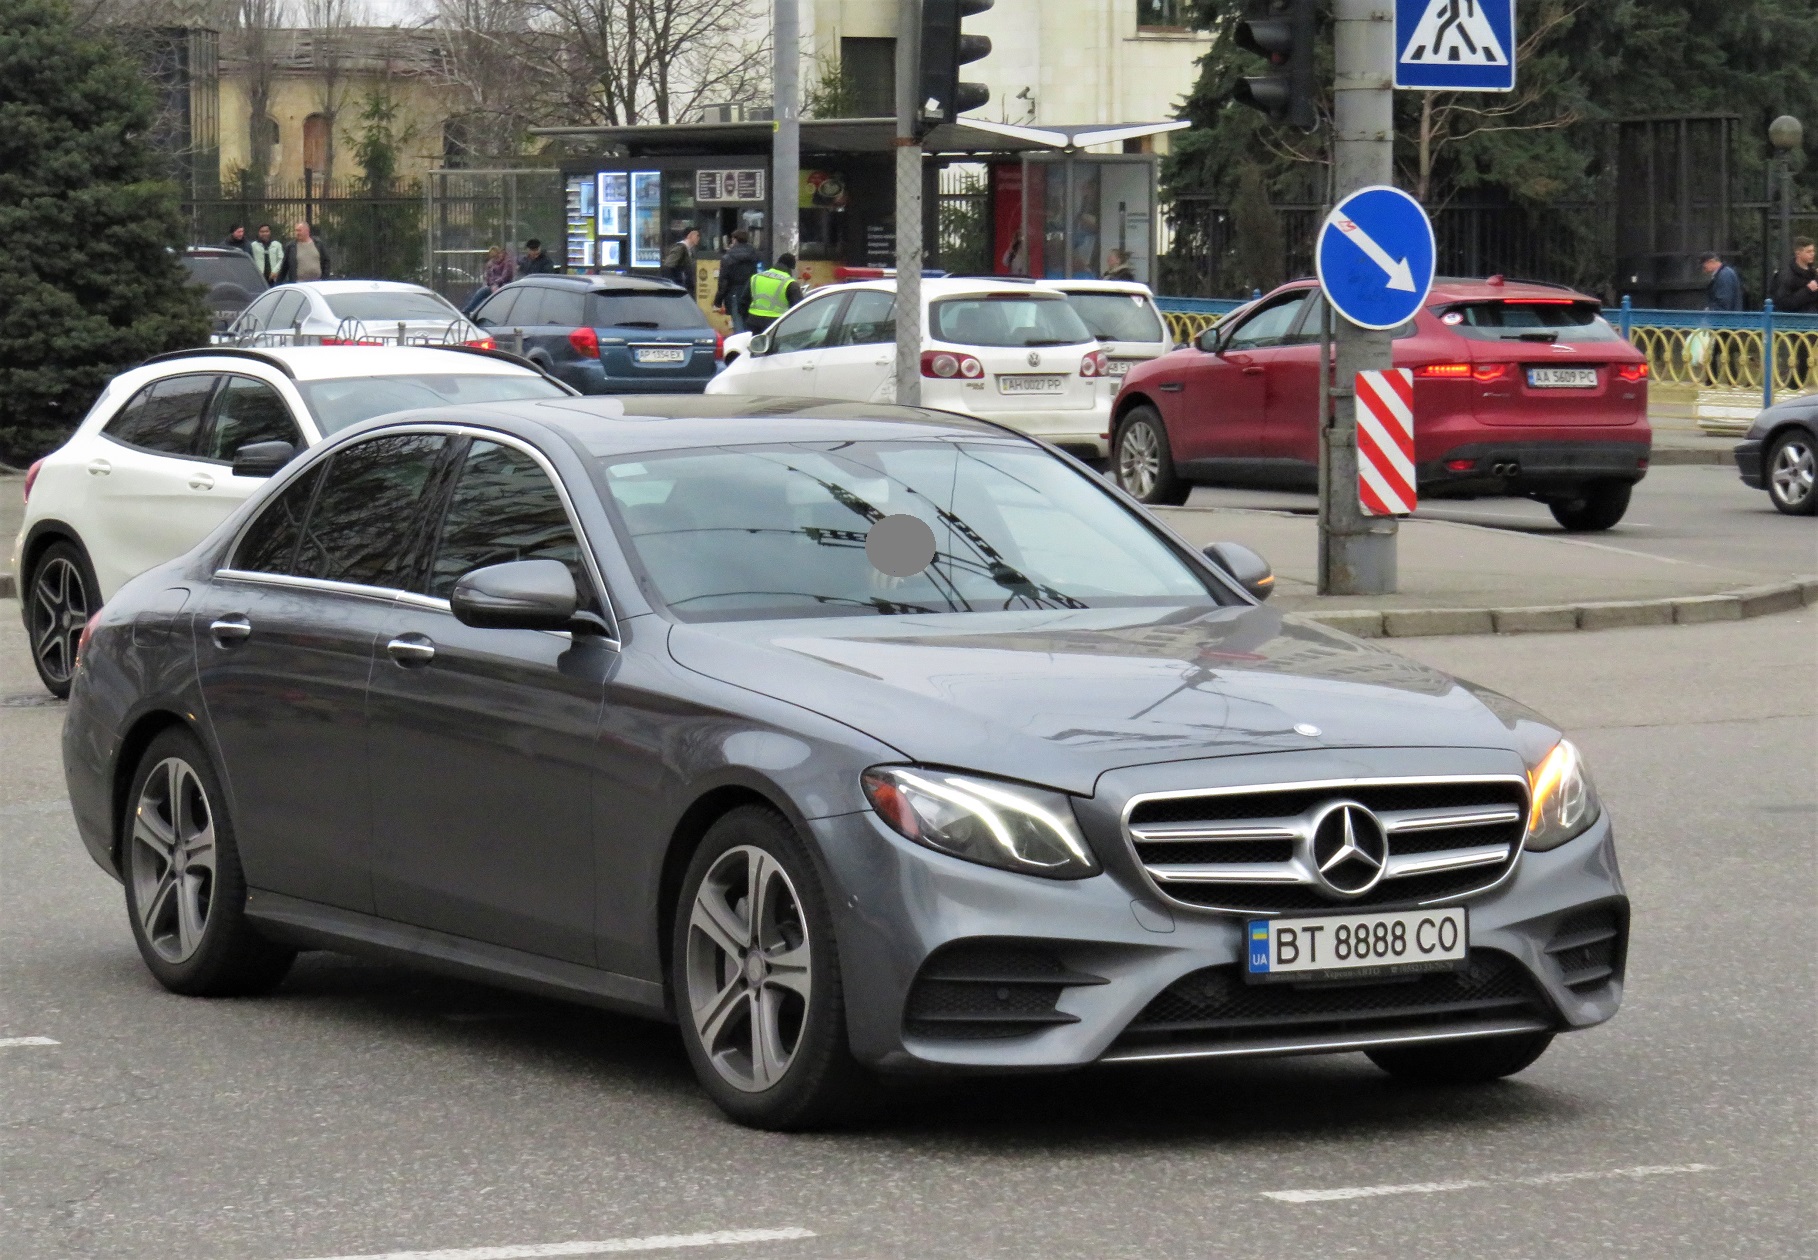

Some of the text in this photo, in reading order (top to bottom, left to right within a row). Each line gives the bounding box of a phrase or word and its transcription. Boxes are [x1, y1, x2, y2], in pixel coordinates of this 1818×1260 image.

[1535, 370, 1551, 383] AA
[1276, 916, 1458, 965] BT 8888 CO
[1252, 953, 1268, 966] UA
